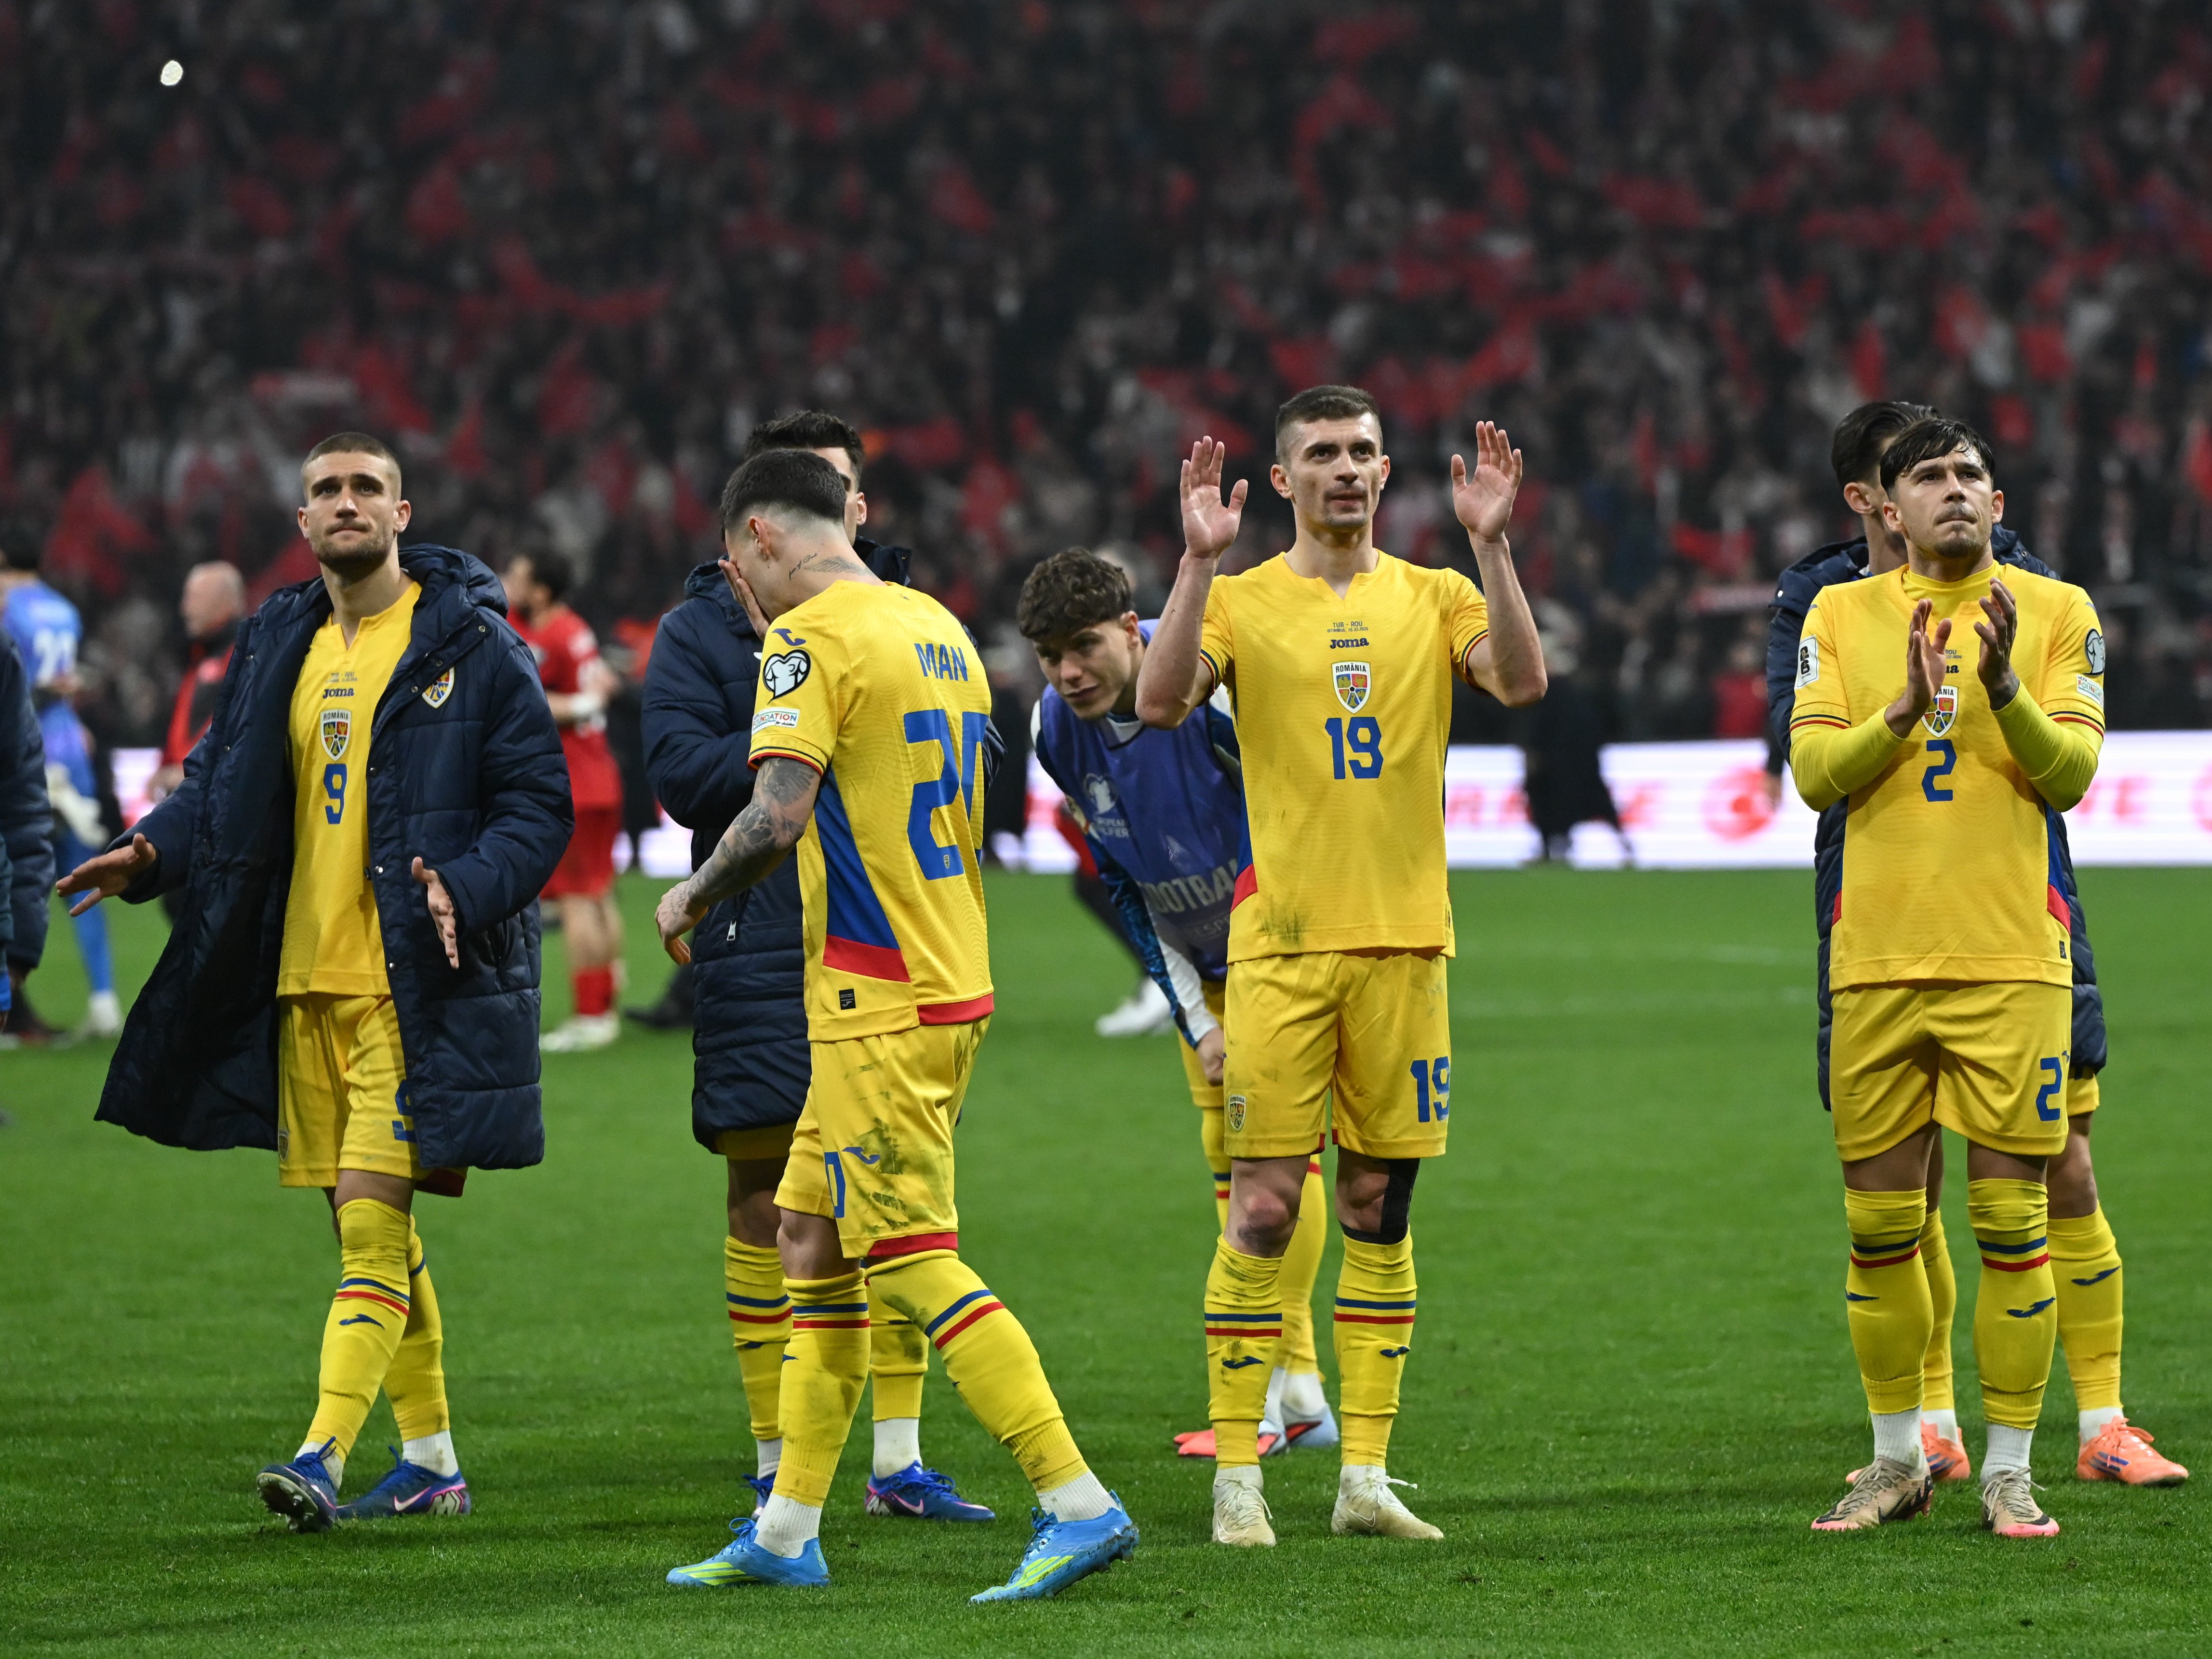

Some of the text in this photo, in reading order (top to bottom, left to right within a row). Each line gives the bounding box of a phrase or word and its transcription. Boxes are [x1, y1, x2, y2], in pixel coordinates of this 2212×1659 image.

[914, 643, 968, 682] MAN
[1329, 638, 1369, 649] Joma
[1335, 663, 1367, 673] ROMÂNIA
[322, 688, 355, 699] Joma
[323, 710, 349, 721] ROMÂNIA
[1325, 716, 1384, 780] 19
[1921, 739, 1957, 802] 2
[323, 763, 348, 825] 9
[1409, 1056, 1450, 1123] 19
[2035, 1057, 2063, 1122] 2
